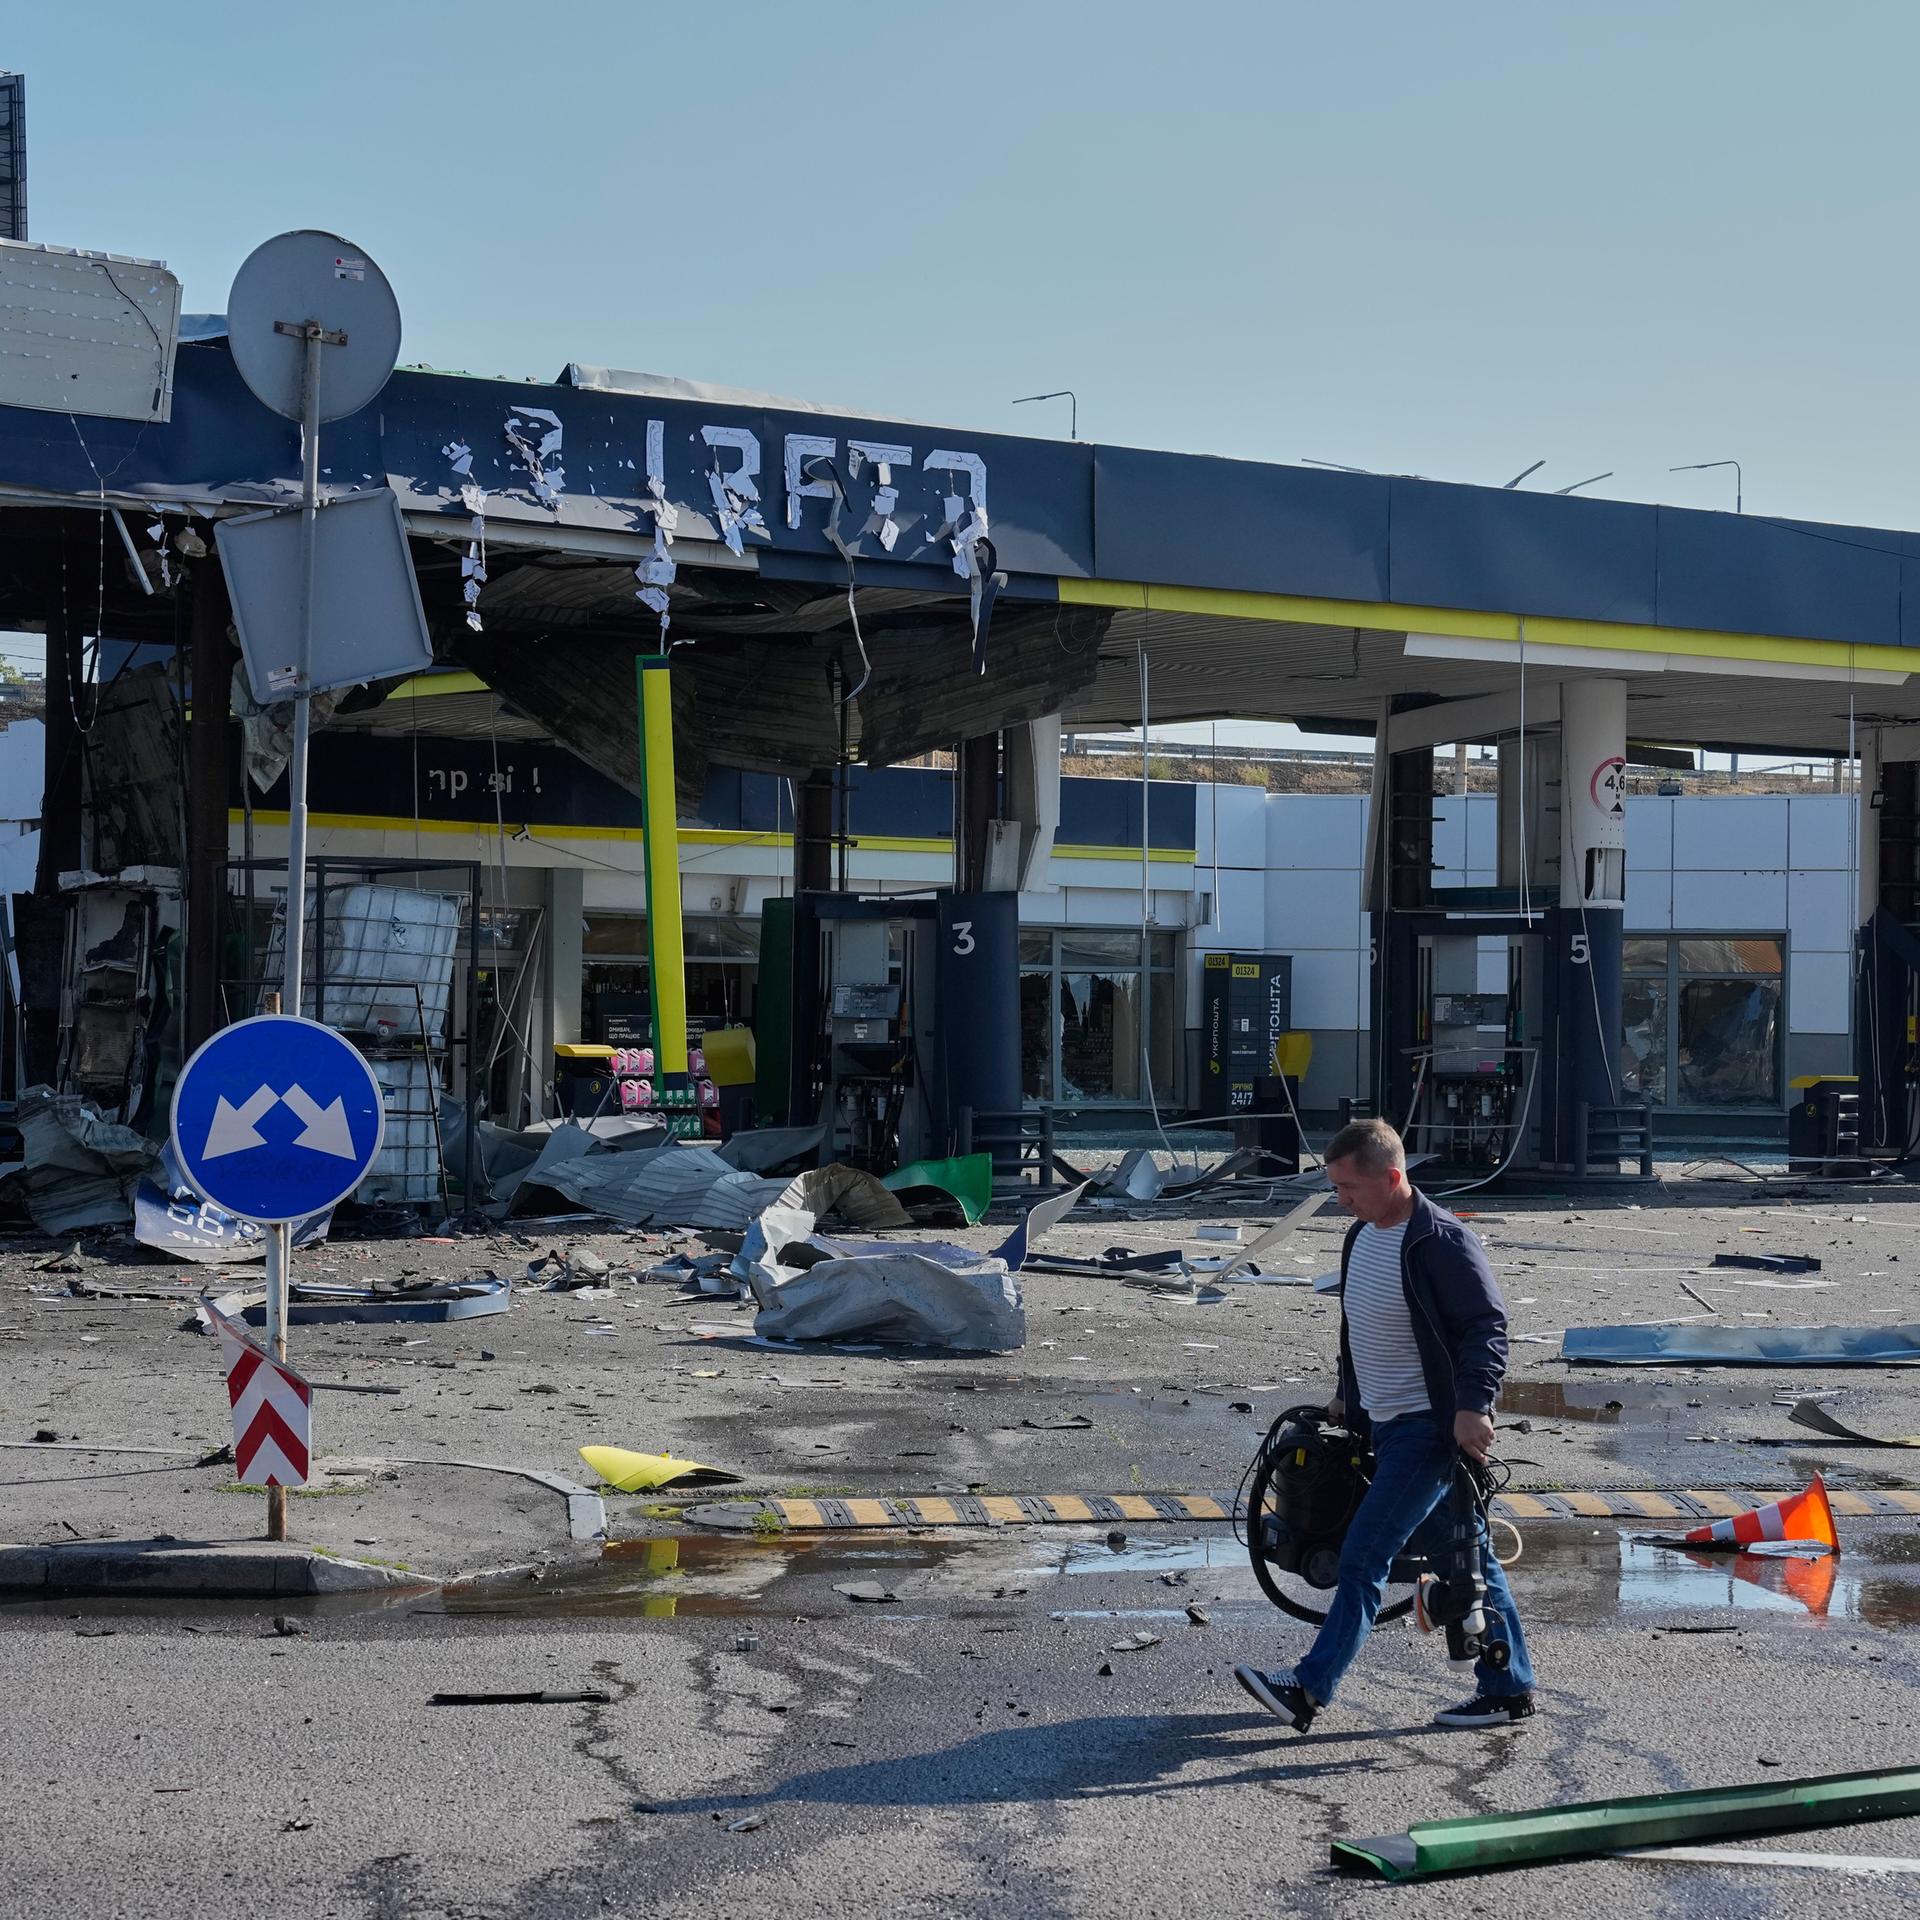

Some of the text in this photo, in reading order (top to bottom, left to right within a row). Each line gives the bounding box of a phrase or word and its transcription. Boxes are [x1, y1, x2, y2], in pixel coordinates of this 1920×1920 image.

[1604, 774, 1625, 793] 4,6
[952, 921, 976, 955] 3
[1570, 934, 1590, 964] 5
[1208, 956, 1226, 967] 01324
[1235, 966, 1255, 976] 01324
[1212, 997, 1220, 1058] УКРПОШТА
[1231, 1092, 1253, 1106] 24/7
